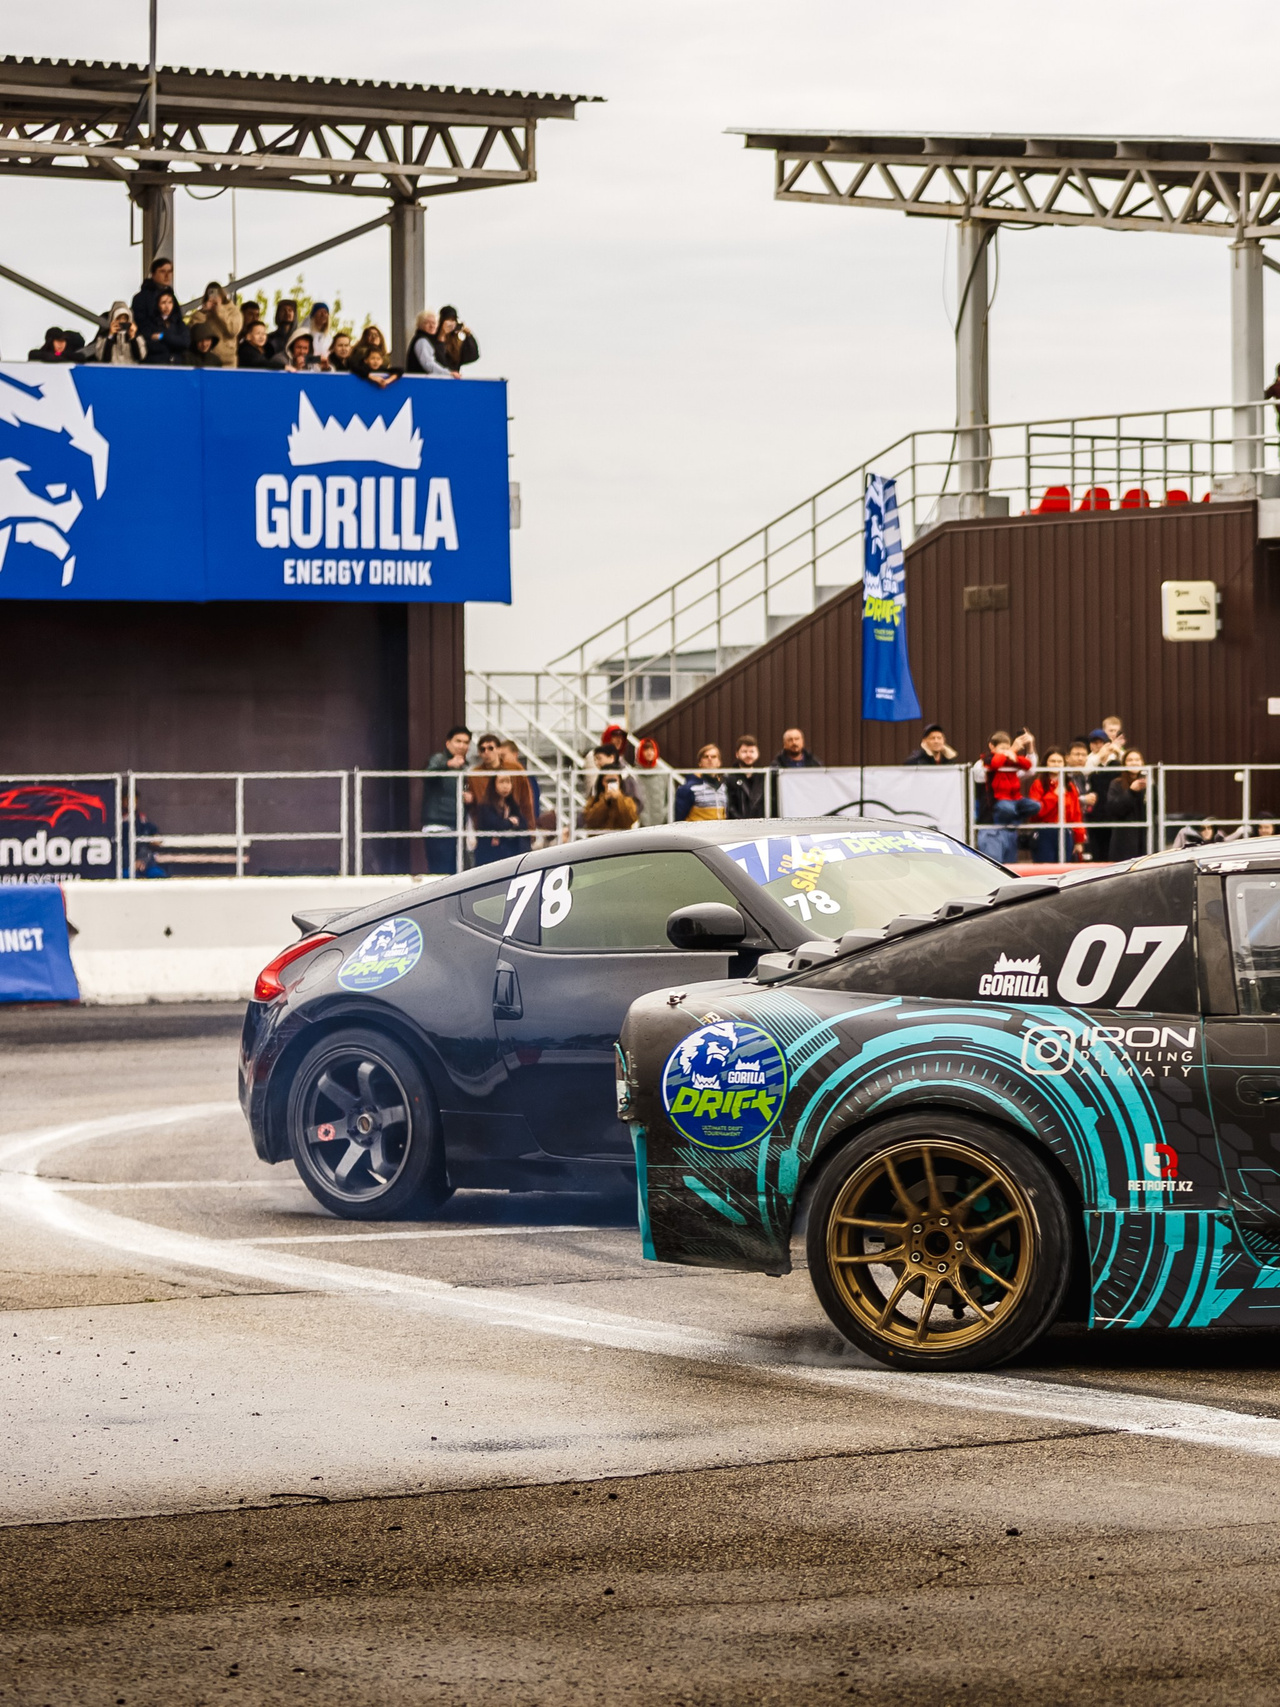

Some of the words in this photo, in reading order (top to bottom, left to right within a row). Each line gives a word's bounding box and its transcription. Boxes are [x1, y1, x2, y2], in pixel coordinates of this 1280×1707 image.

[256, 474, 459, 550] GORILLA
[283, 559, 365, 585] ENERGY
[369, 560, 432, 586] DRINK
[503, 865, 573, 937] 78
[782, 889, 841, 922] 78
[339, 957, 412, 976] DRIFT
[1056, 923, 1188, 1008] 07
[979, 973, 1049, 997] GORILLA
[1081, 1026, 1196, 1048] IRON
[1080, 1050, 1194, 1062] DETAILING
[727, 1071, 765, 1084] GORILLA
[1080, 1065, 1192, 1077] ALMATY
[669, 1086, 777, 1122] DRIFT
[1128, 1180, 1193, 1192] RETROFIT.KZ
